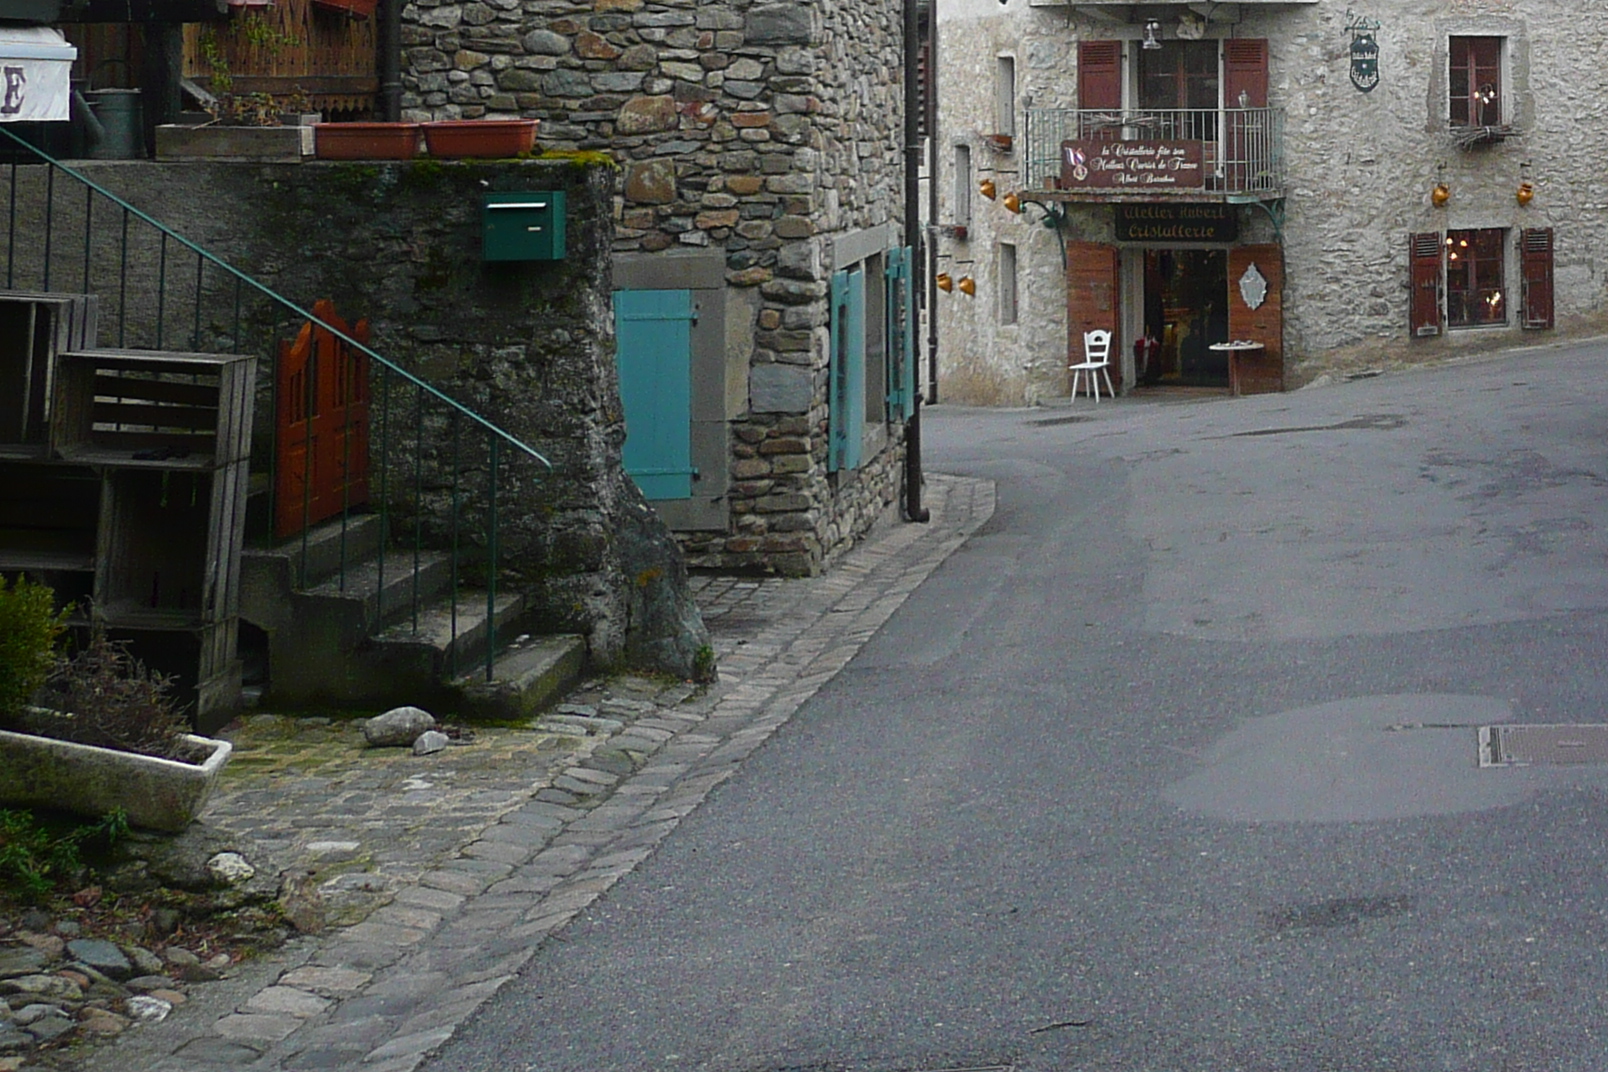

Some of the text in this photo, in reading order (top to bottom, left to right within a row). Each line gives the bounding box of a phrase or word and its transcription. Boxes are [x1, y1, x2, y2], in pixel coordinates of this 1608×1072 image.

[1157, 159, 1167, 170] de
[1167, 157, 1199, 171] France
[1124, 206, 1226, 220] Atelier Hubert
[1128, 224, 1216, 238] Cristallerie
